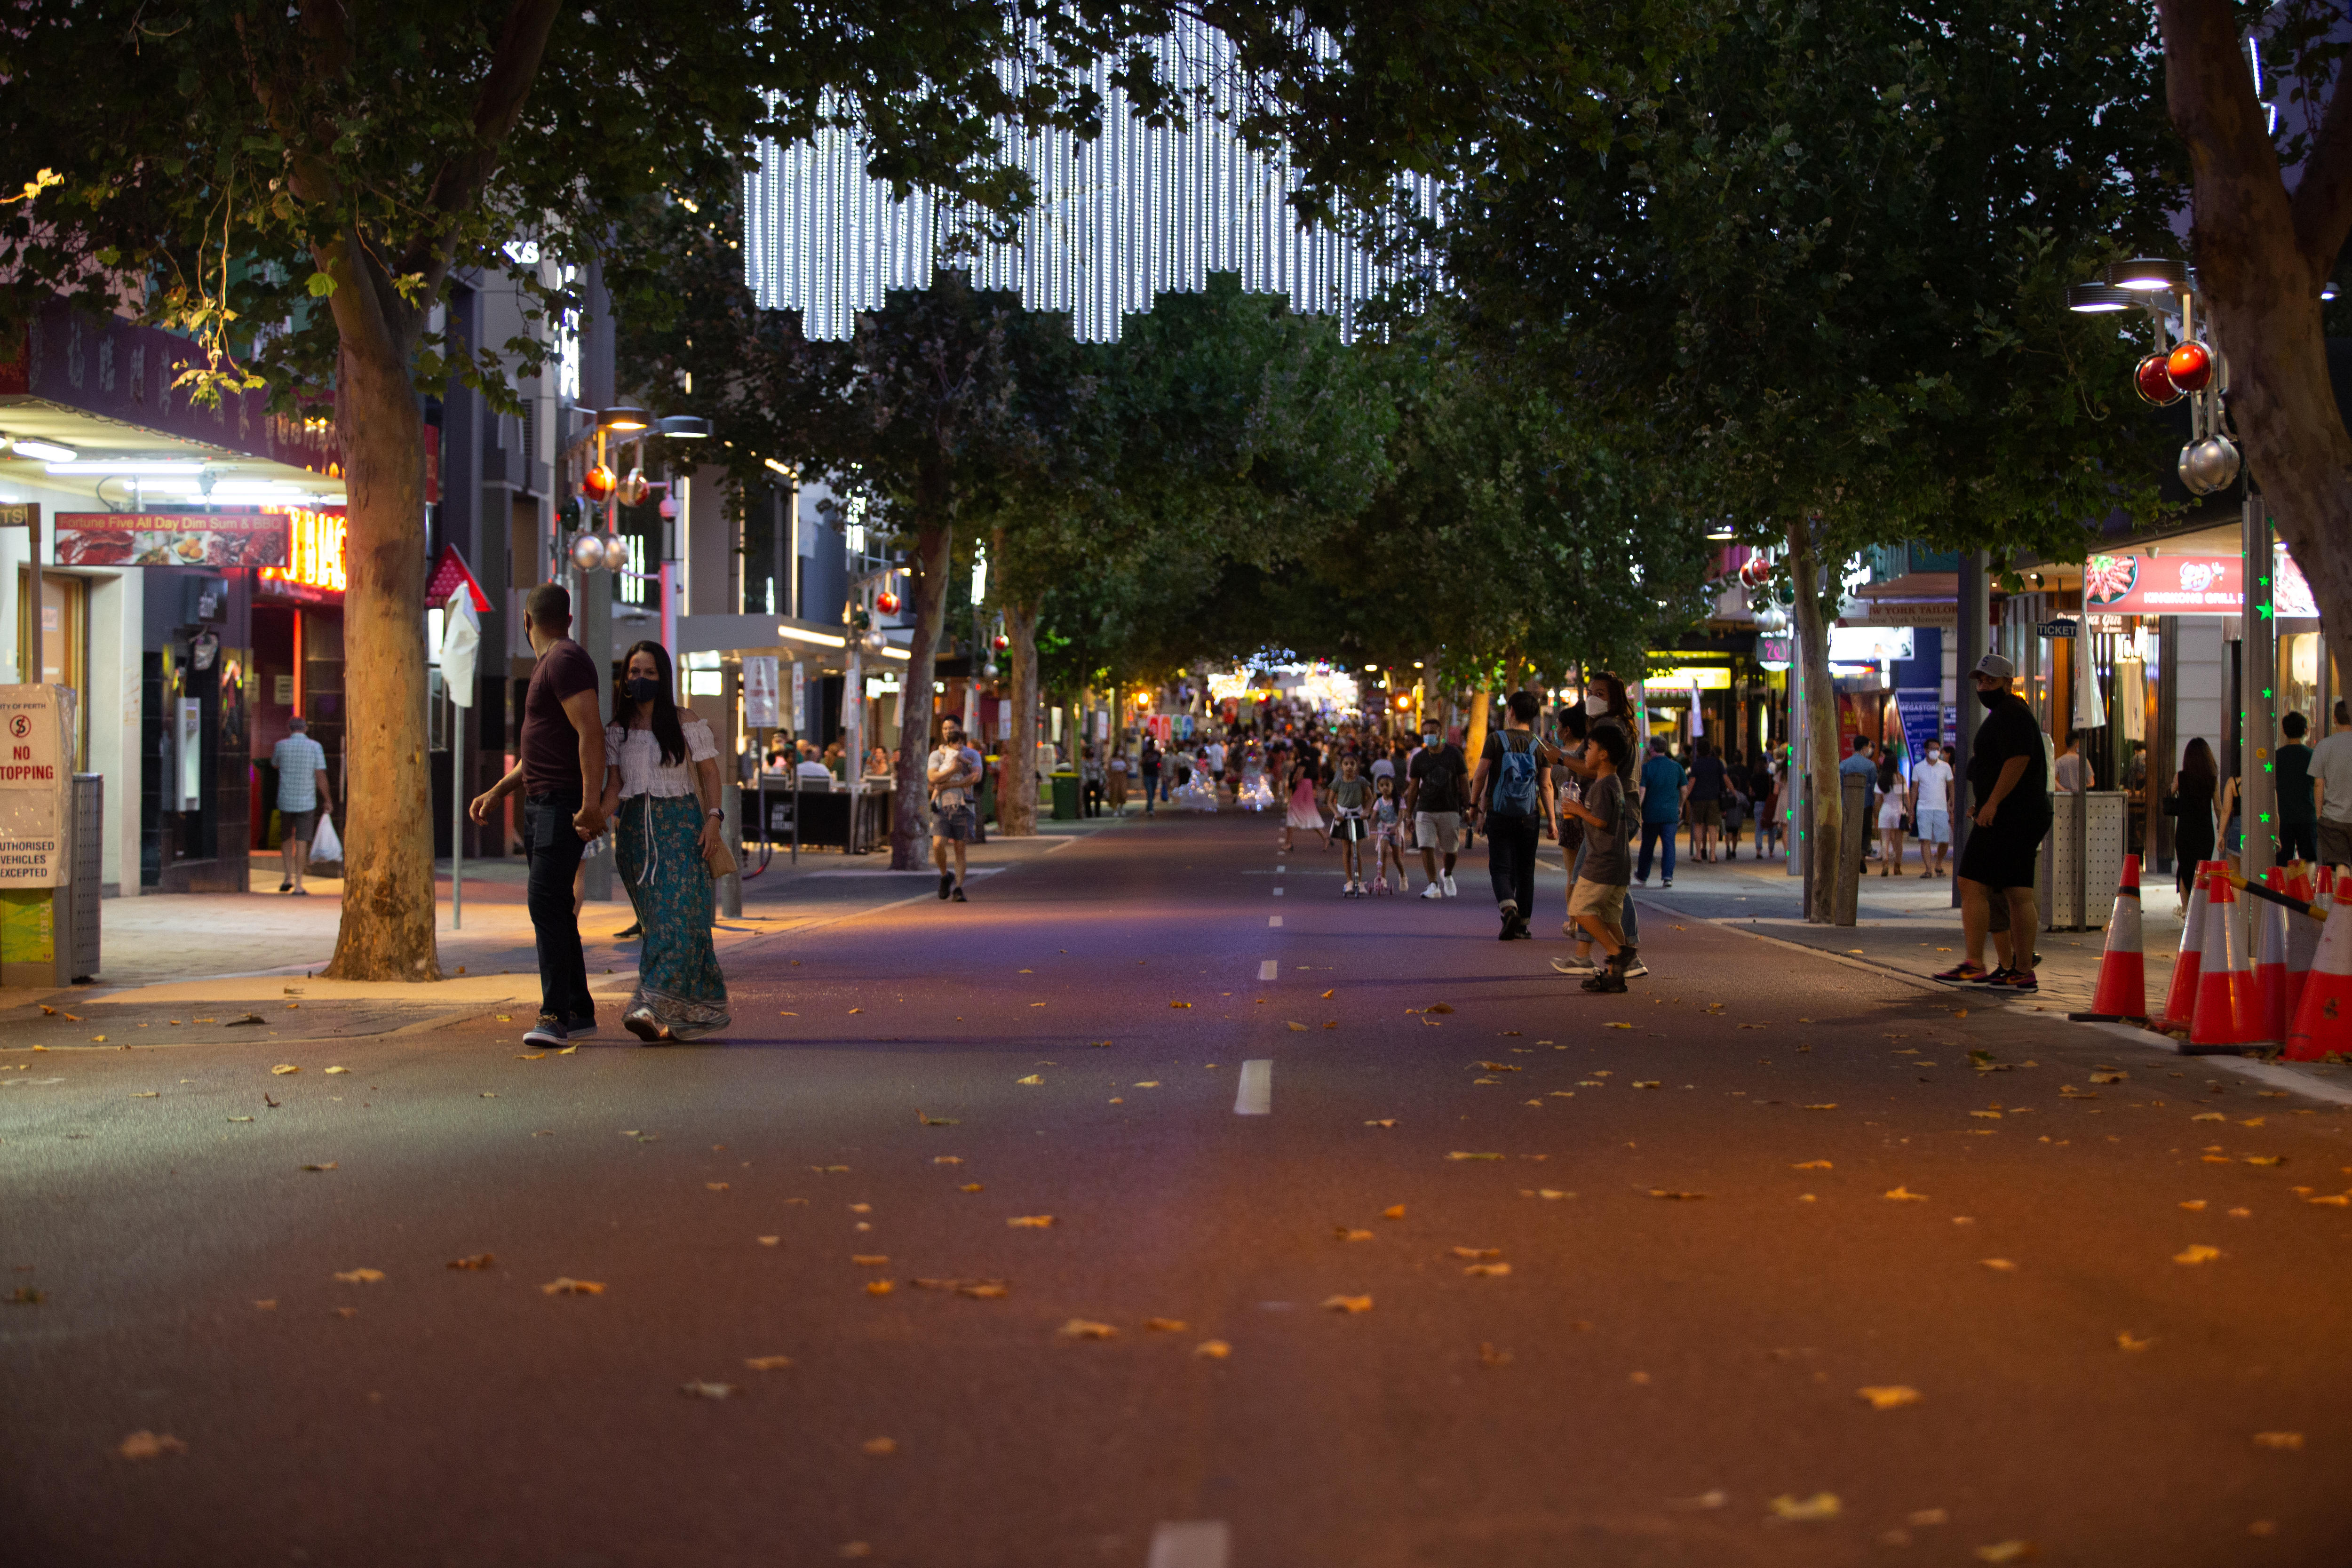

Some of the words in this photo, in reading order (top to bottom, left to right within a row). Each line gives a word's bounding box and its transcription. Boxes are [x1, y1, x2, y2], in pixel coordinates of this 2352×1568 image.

[59, 517, 105, 529] Fortune
[109, 517, 135, 529] Five
[136, 517, 152, 529] All
[154, 517, 179, 531] Day
[182, 517, 207, 529] Dim
[210, 518, 238, 529] Sum
[240, 518, 250, 529] &
[2144, 592, 2203, 604] KINGKONG
[2204, 592, 2236, 604] GRILL
[1885, 606, 1916, 615] YORK
[13, 746, 31, 760] NO
[0, 766, 54, 780] TOPPING
[0, 854, 46, 864] VEHICLES
[0, 868, 48, 877] EXCEPTED
